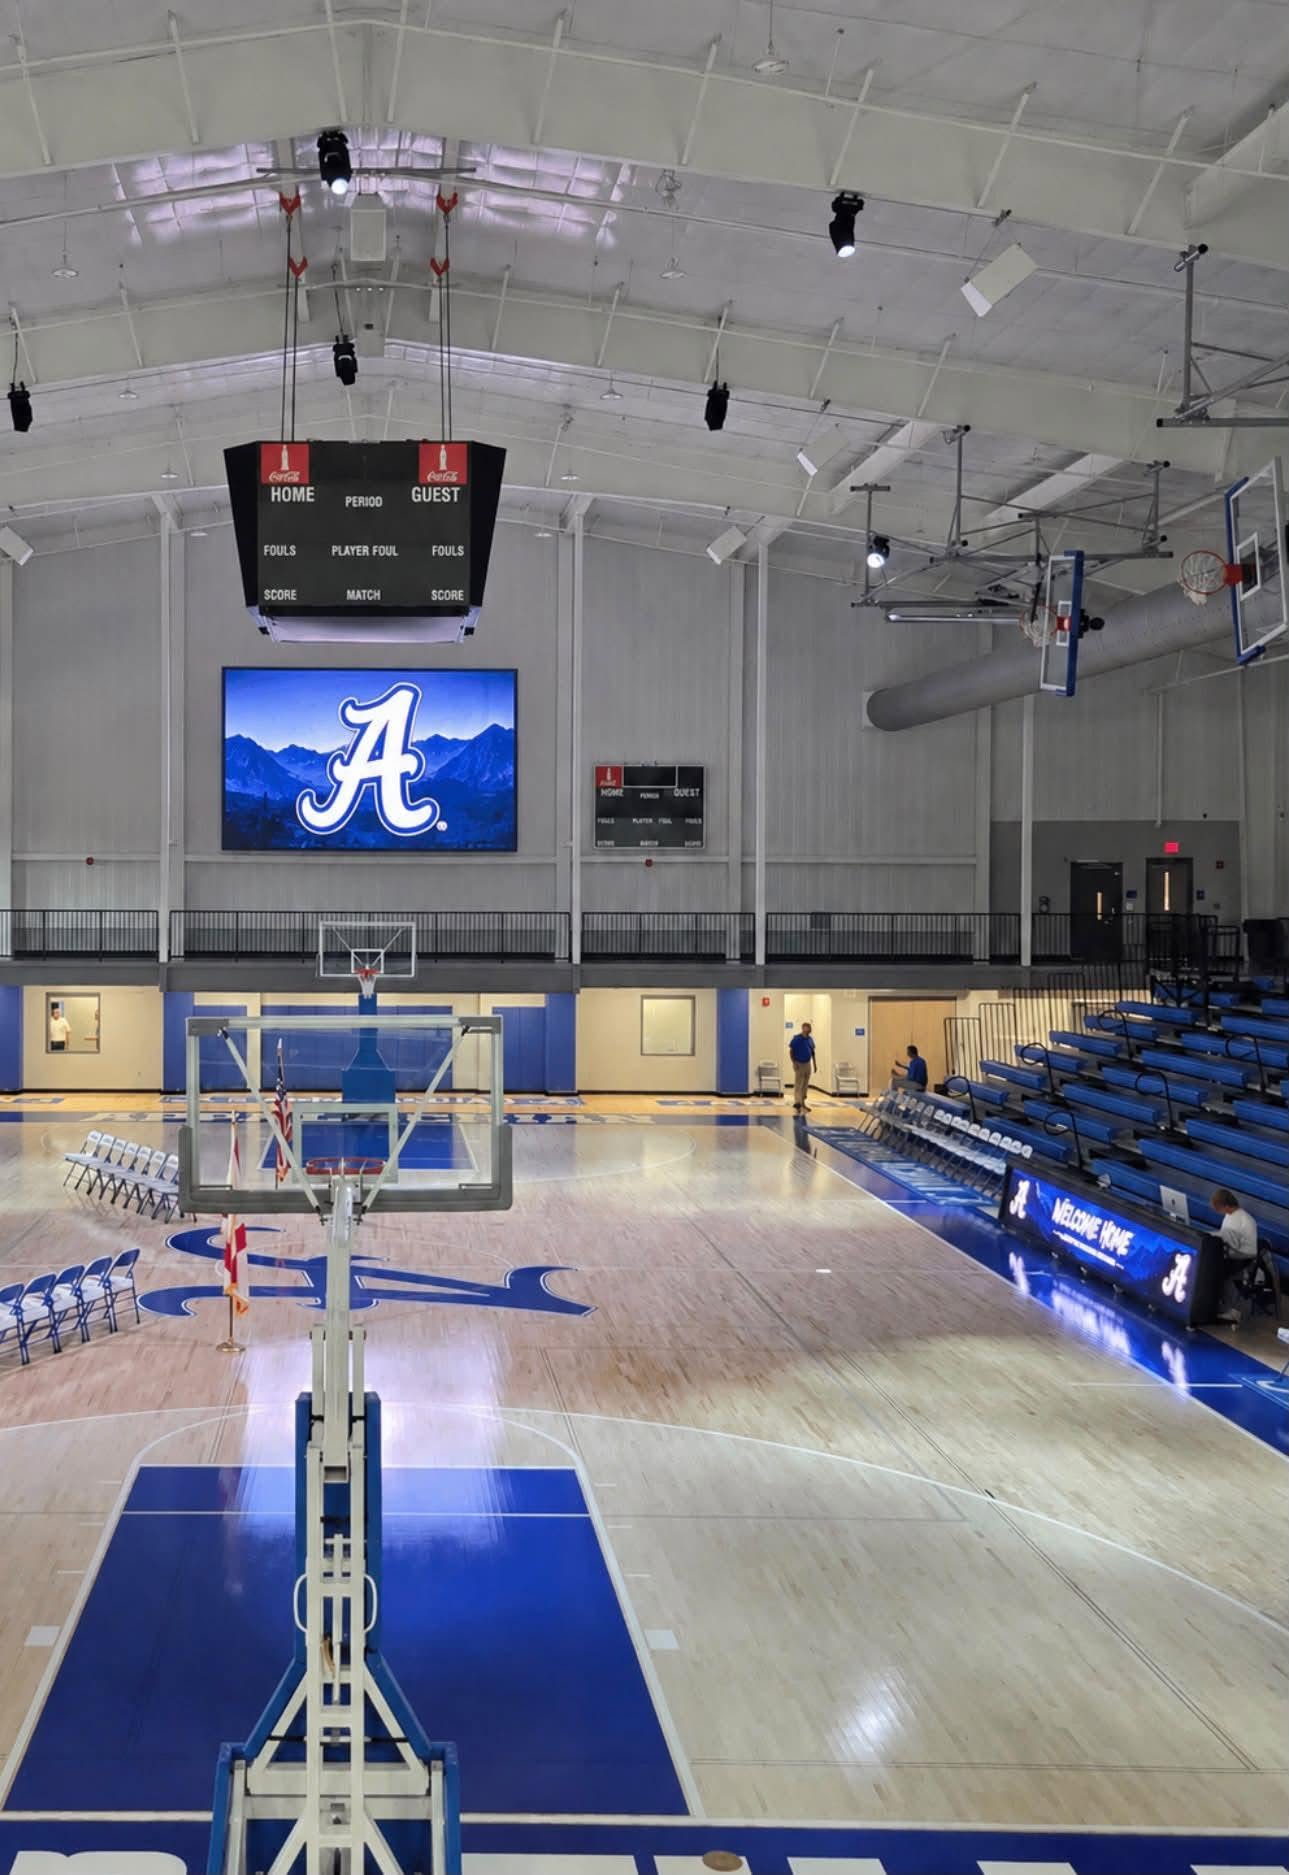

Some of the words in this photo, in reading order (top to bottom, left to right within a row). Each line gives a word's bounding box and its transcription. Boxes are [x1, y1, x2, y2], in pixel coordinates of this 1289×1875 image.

[271, 486, 315, 502] HOME
[411, 486, 461, 502] GUEST
[345, 496, 383, 508] PERIOD
[263, 545, 296, 557] FOULS
[331, 545, 369, 557] PLAYER
[372, 545, 399, 557] FOUL
[432, 545, 464, 557] FOULS
[264, 589, 297, 601] SCORE
[346, 589, 381, 601] MATCH
[431, 589, 464, 601] SCORE
[296, 682, 440, 836] A
[1052, 1197, 1103, 1241] WELCOME
[1100, 1219, 1136, 1257] HOME
